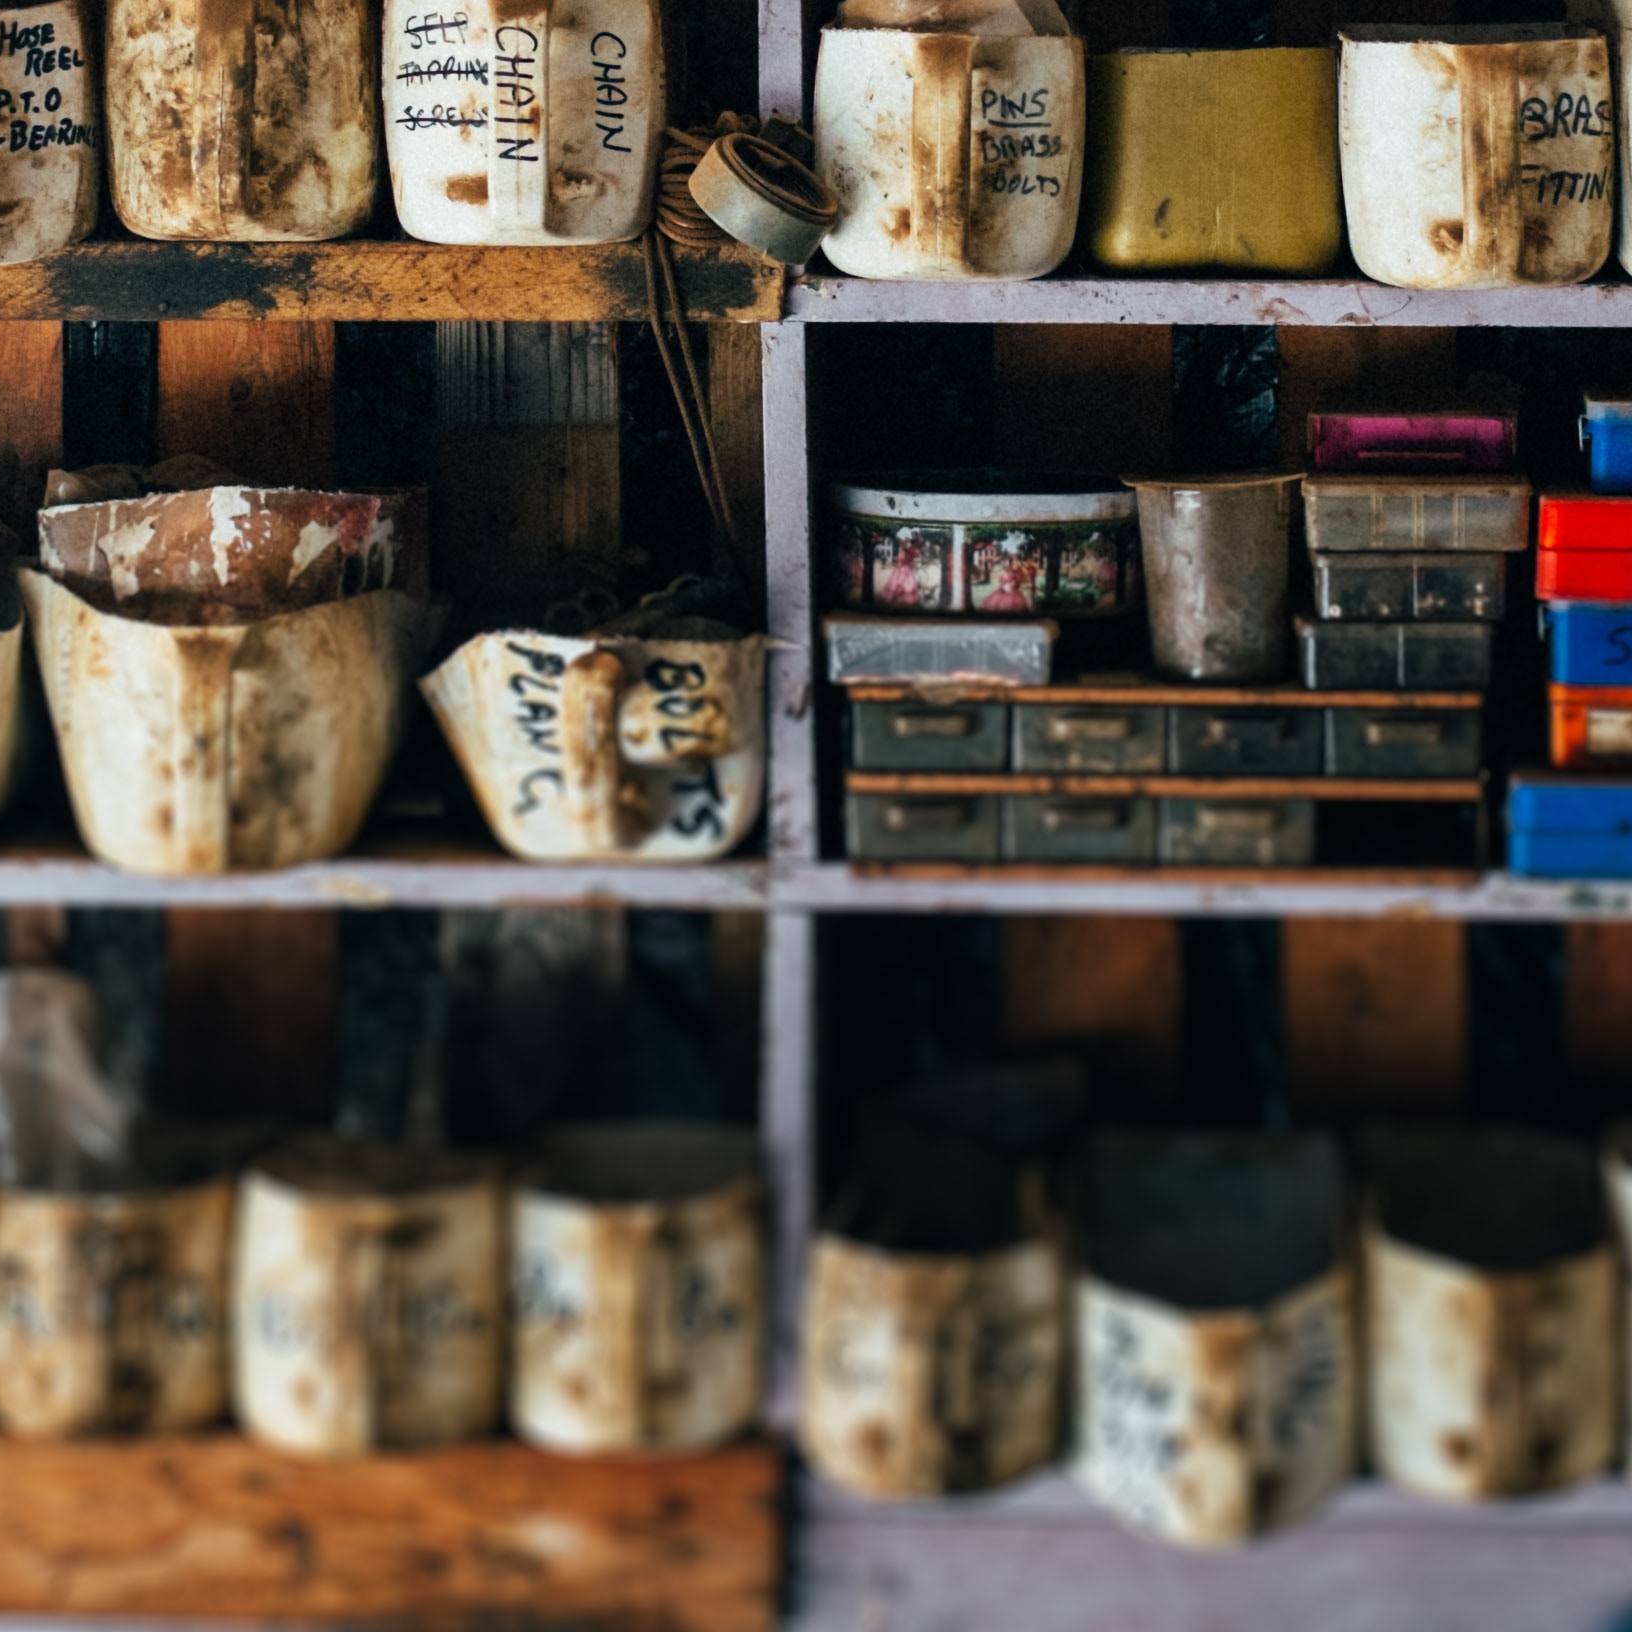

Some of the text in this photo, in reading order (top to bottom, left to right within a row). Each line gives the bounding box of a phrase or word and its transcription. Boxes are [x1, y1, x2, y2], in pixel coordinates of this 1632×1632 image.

[24, 46, 84, 77] REEL
[495, 26, 538, 162] CHAIN
[591, 31, 632, 152] CHAIN
[981, 89, 1049, 119] PINS
[980, 131, 1061, 164] BRASS
[992, 168, 1060, 197] BOLTS
[644, 659, 726, 843] BOLTS
